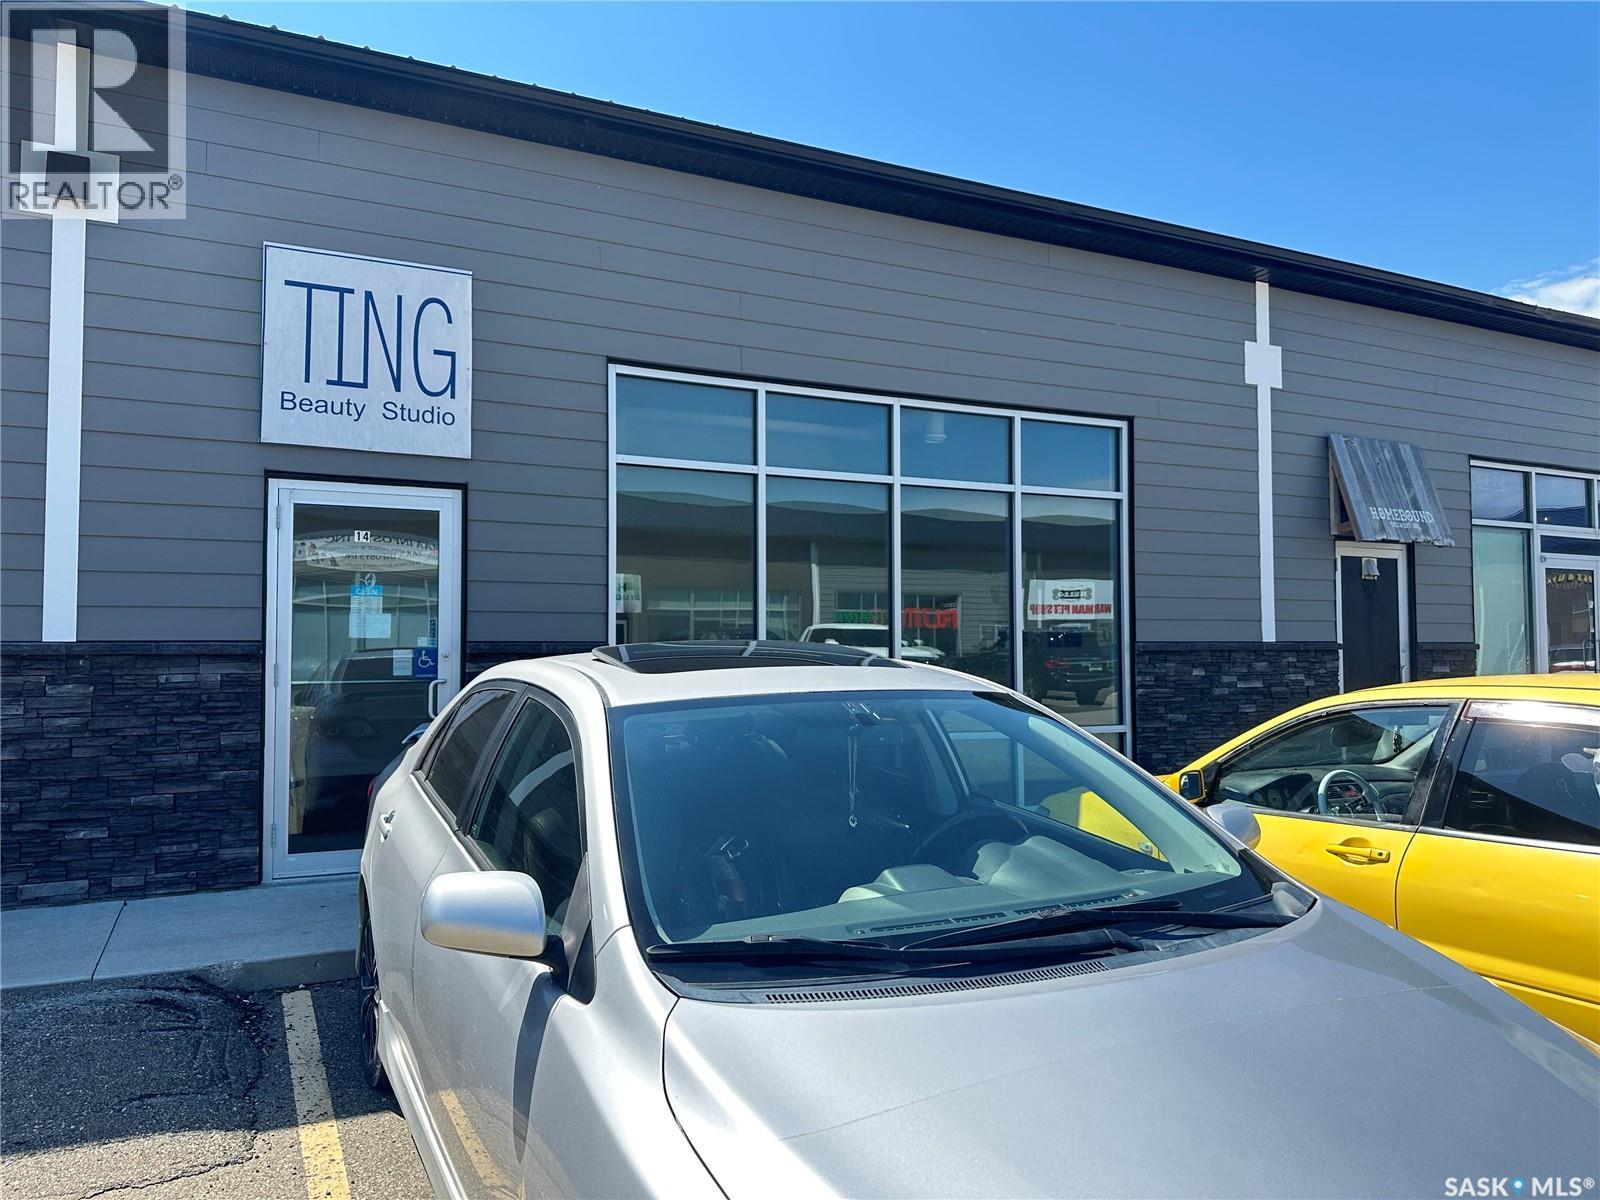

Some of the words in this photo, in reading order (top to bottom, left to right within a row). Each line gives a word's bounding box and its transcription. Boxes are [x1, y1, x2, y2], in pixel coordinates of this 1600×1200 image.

[284, 279, 456, 399] TING
[280, 391, 366, 422] Beauty
[382, 401, 456, 426] Studio
[1369, 506, 1434, 524] HOMEBOUND
[356, 531, 369, 541] 14
